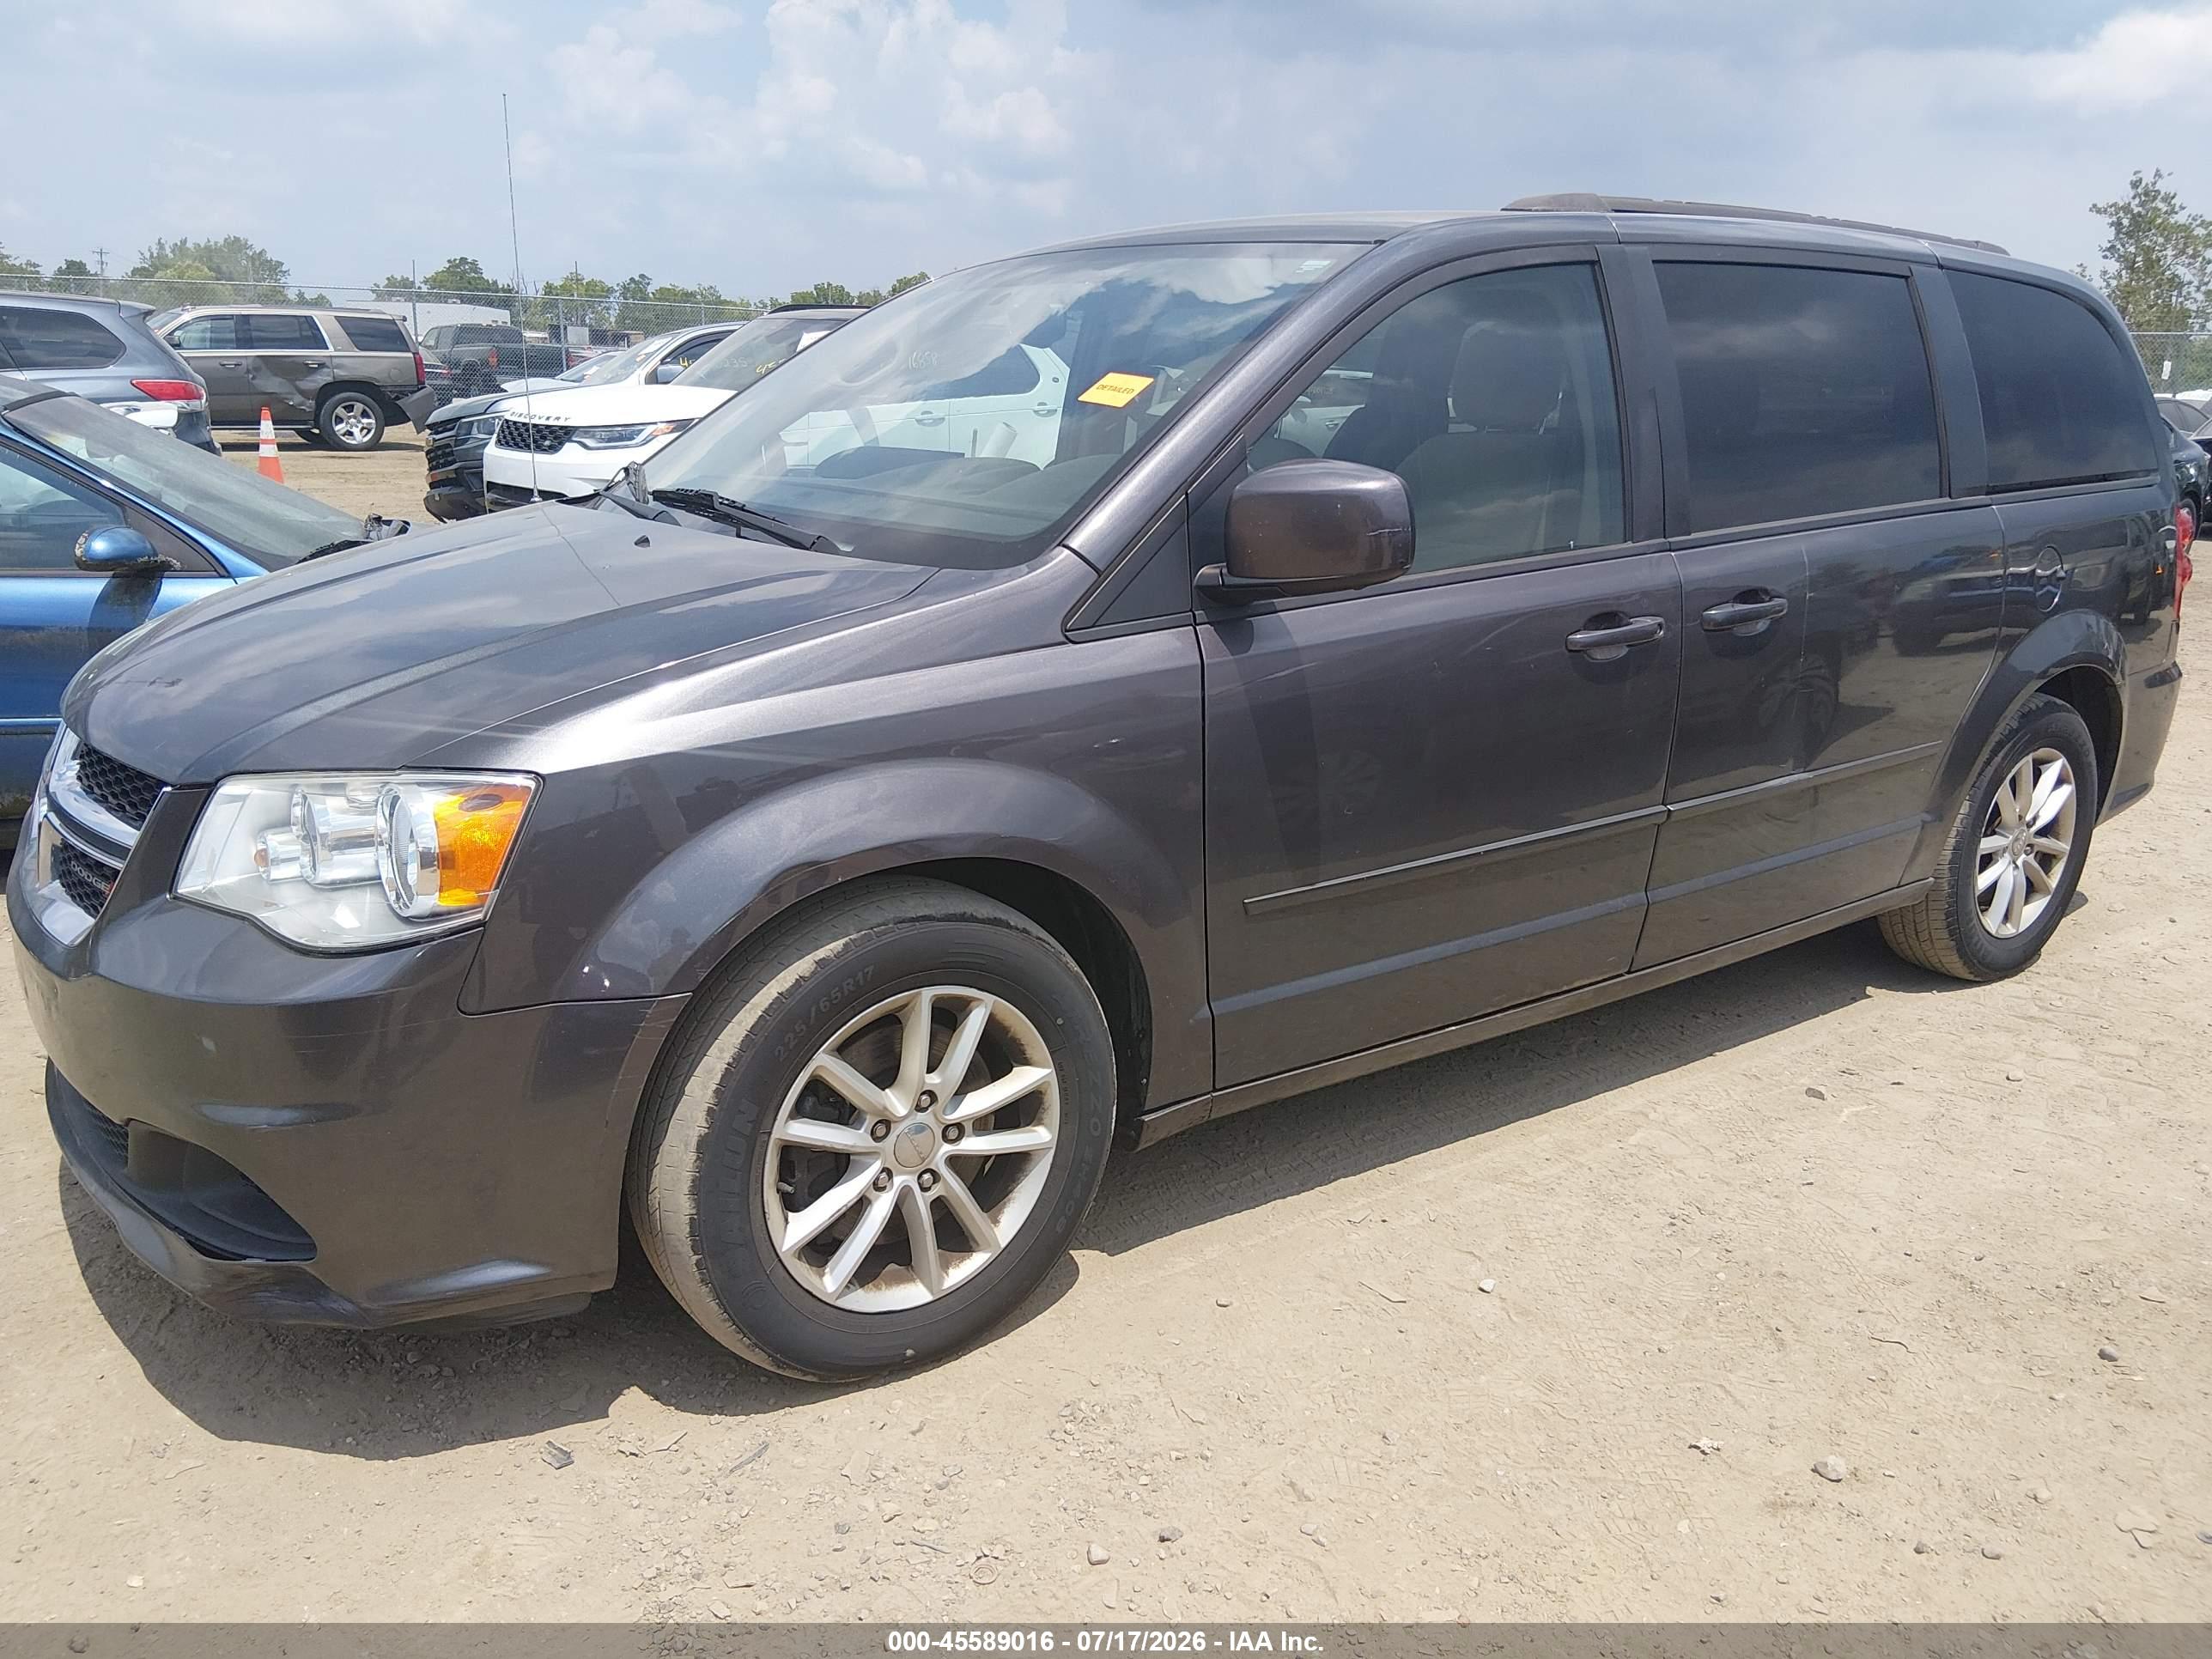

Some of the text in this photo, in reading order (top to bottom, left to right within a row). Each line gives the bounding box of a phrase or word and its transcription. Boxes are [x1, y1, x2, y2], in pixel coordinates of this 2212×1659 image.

[1096, 384, 1134, 395] DETAILED
[509, 410, 572, 422] DISCOVERY
[70, 860, 111, 894] DODGE
